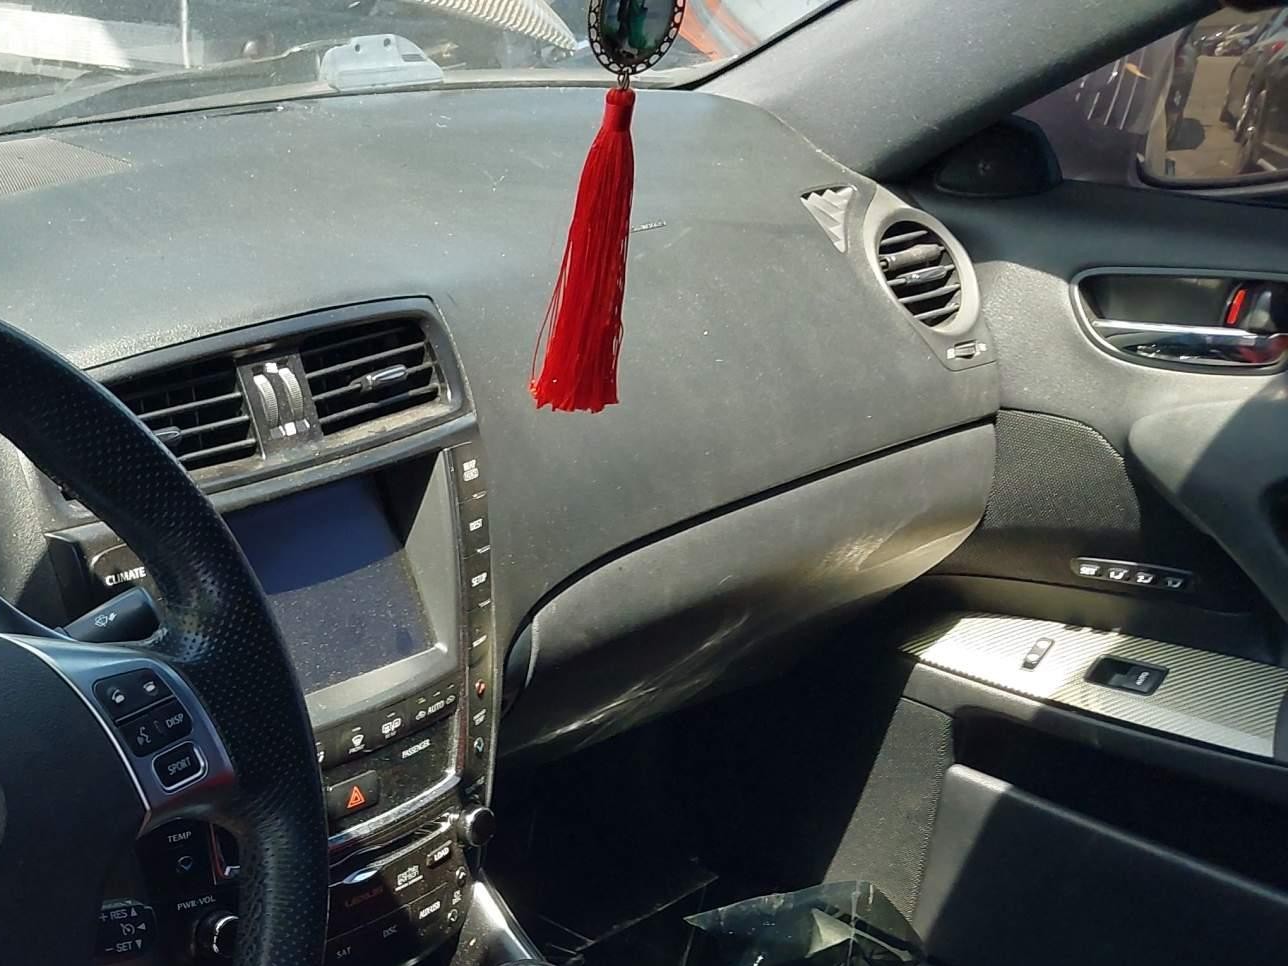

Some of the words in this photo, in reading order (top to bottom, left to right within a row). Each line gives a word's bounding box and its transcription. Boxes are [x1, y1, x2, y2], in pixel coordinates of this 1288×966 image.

[105, 566, 147, 586] CLIMATE
[427, 700, 445, 715] AUTO
[165, 712, 185, 729] DISP
[167, 756, 192, 776] SPORT
[167, 831, 192, 844] TEMP
[433, 846, 450, 862] LOAD
[110, 909, 128, 921] RES
[115, 940, 133, 953] SET
[336, 946, 352, 959] SAT
